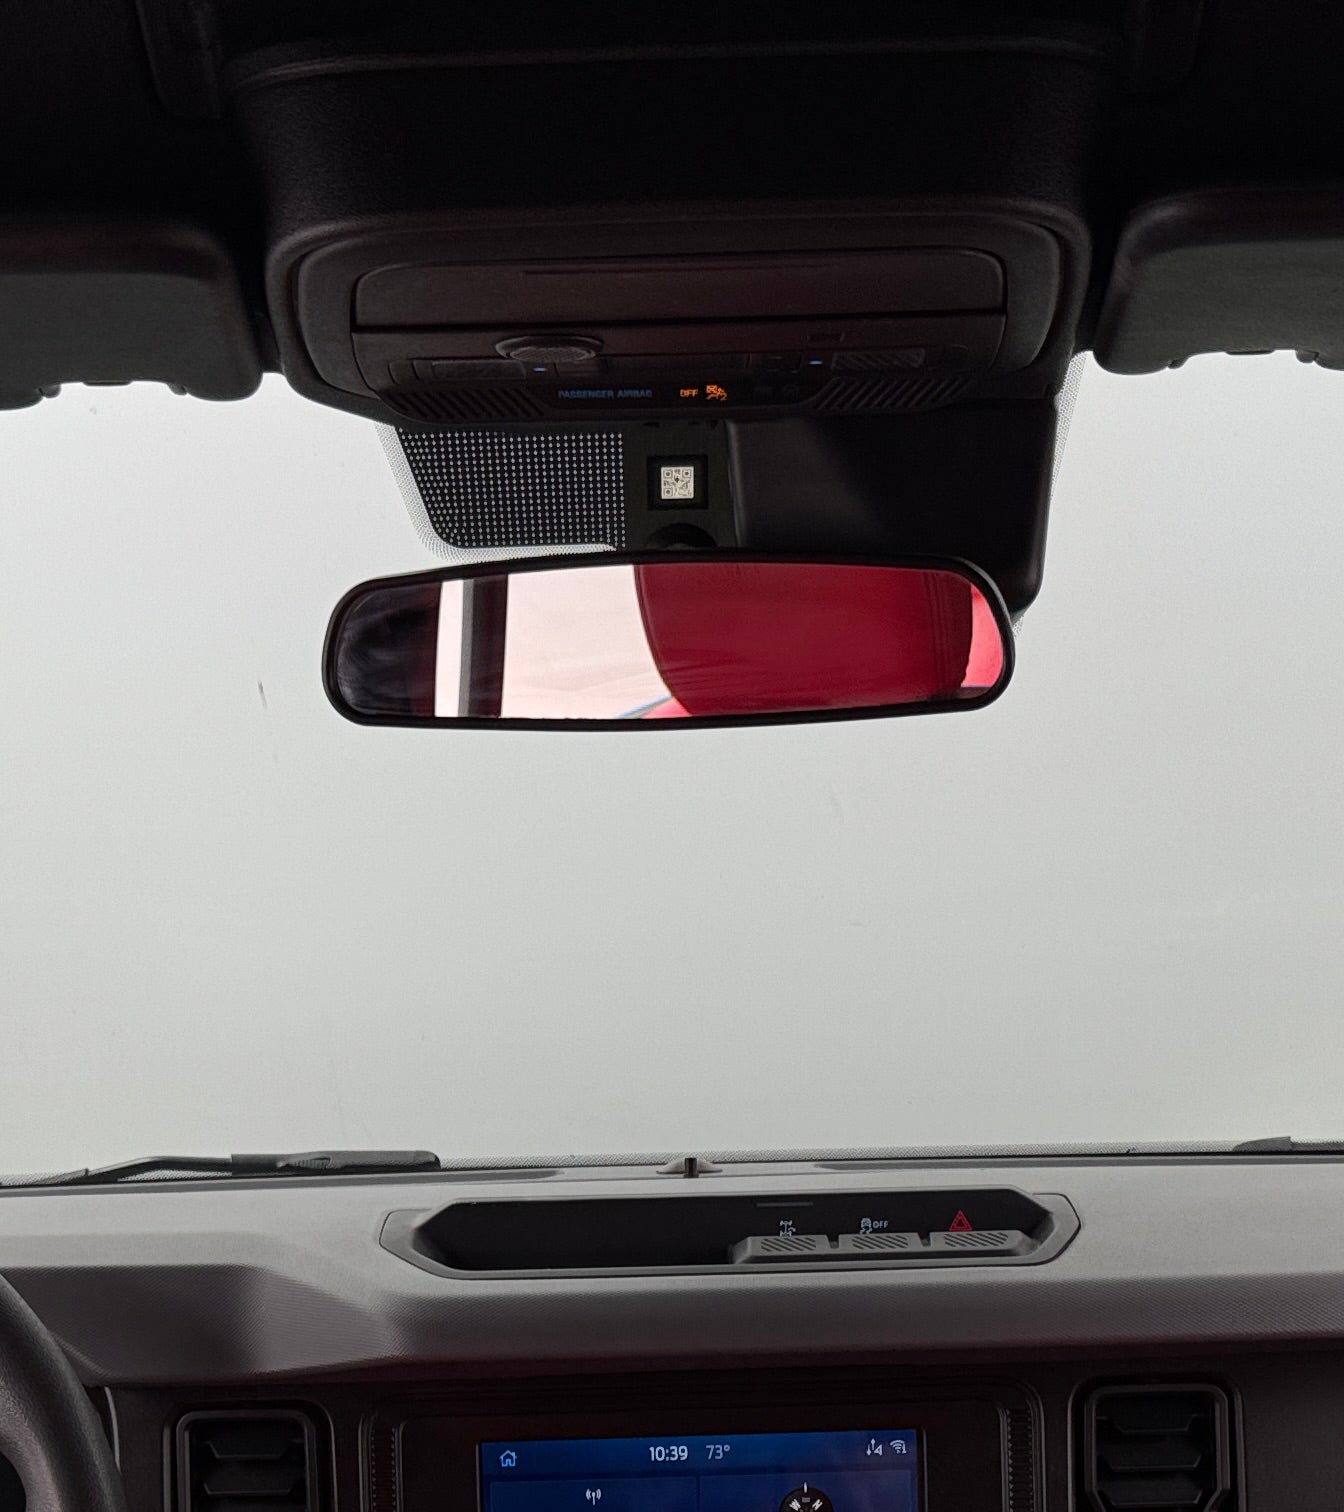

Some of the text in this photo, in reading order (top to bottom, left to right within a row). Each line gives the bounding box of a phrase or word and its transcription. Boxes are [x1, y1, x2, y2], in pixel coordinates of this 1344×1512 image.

[679, 387, 699, 398] OFF
[872, 1219, 889, 1230] OFF
[648, 1443, 731, 1462] 10:39 73°
